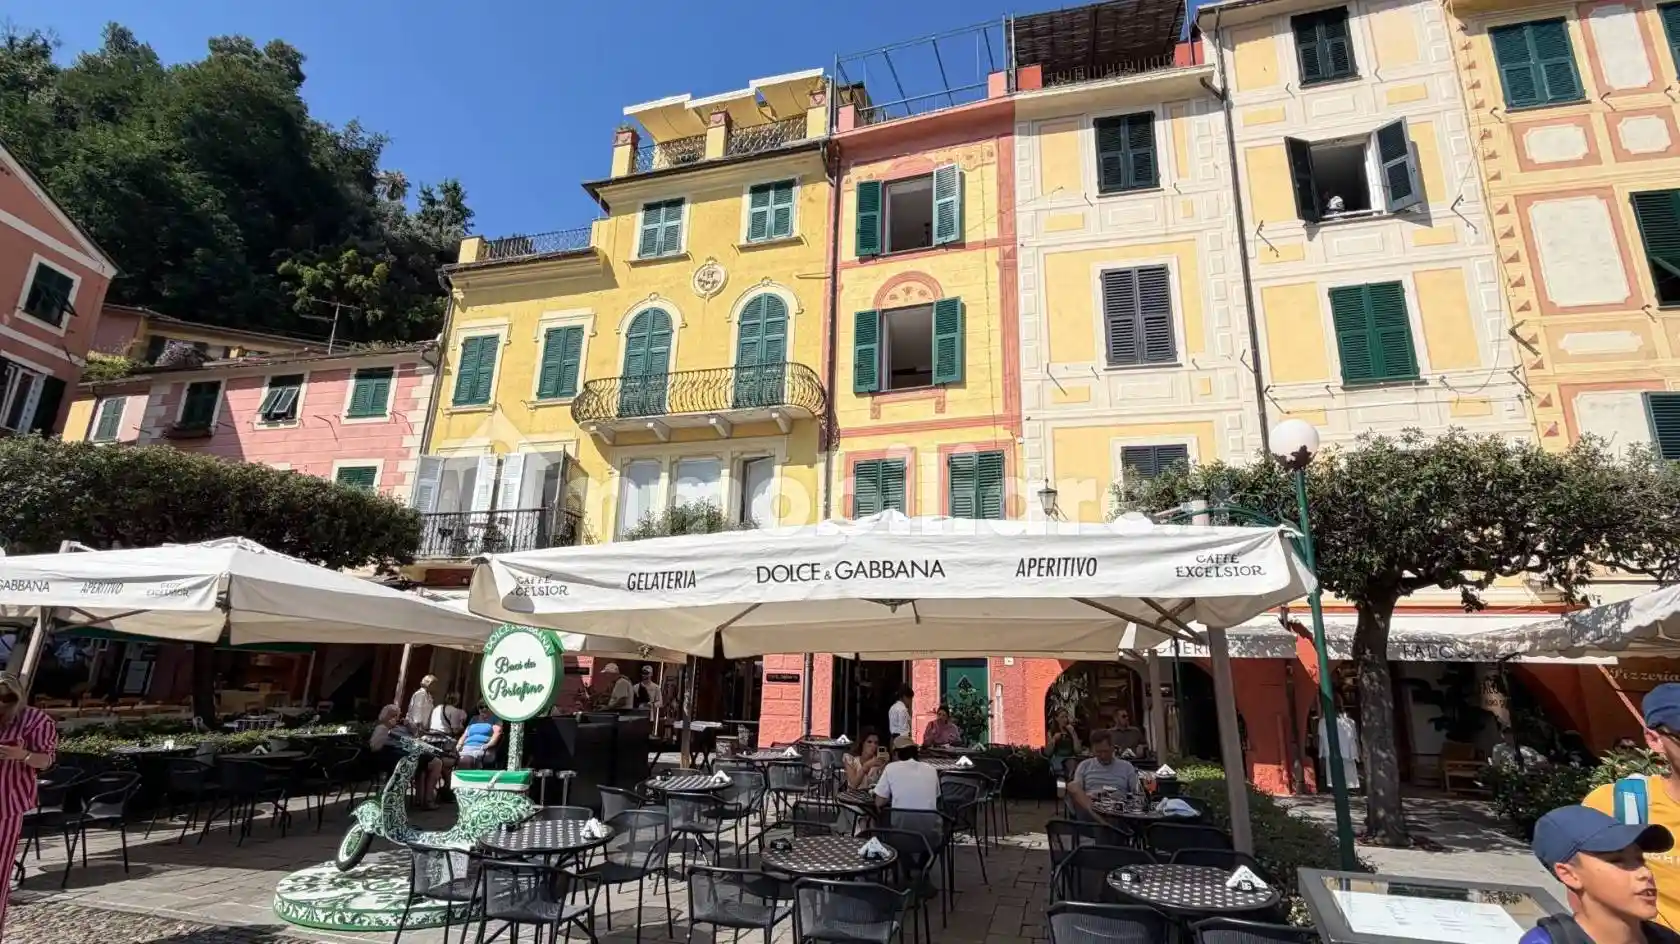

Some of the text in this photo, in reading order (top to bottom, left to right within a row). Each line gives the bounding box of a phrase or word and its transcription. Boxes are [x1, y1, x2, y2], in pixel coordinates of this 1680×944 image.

[756, 559, 946, 584] DOLCE & GABBANA
[1015, 557, 1098, 578] APERITIVO
[1175, 565, 1267, 578] EXCELSIOR
[80, 581, 125, 595] APERITIVO
[626, 569, 697, 591] GELATERIA
[508, 584, 570, 596] CELSIOR
[495, 656, 522, 674] Baci
[1609, 666, 1680, 682] Pizzeria
[488, 676, 545, 702] Portofino
